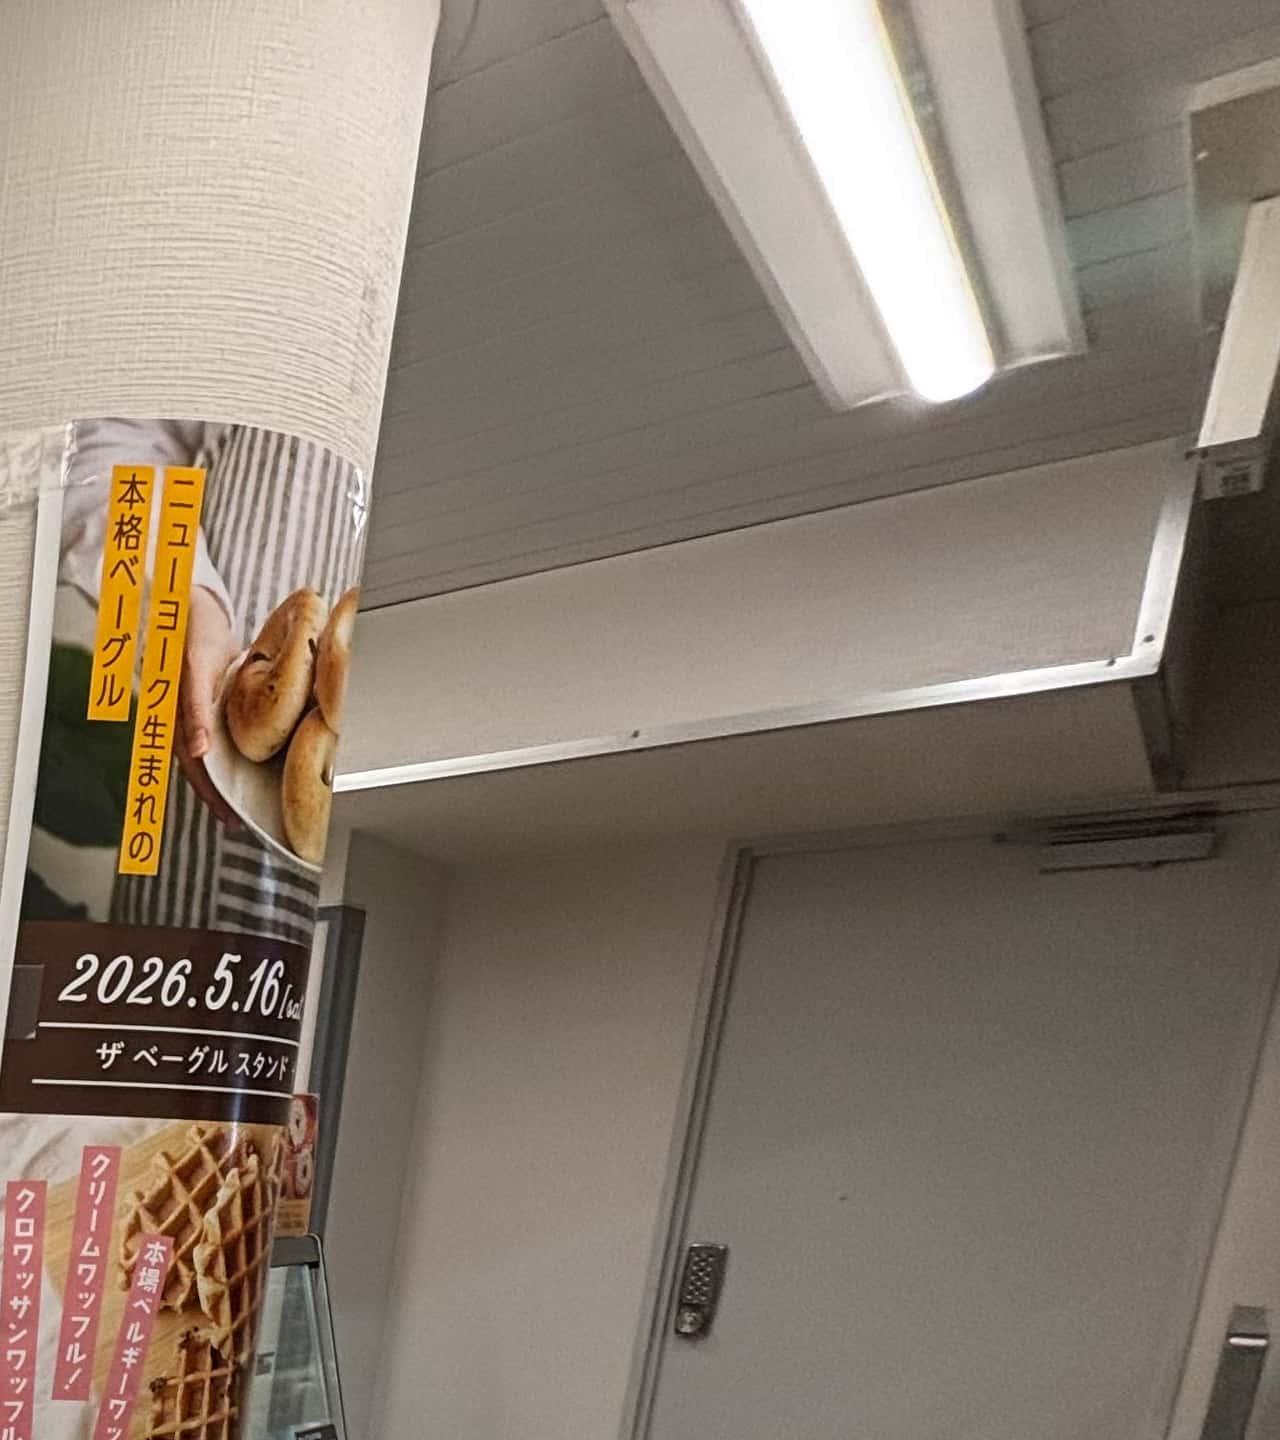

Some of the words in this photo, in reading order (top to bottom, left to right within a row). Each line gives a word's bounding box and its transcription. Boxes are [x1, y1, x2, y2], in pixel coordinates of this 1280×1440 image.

[95, 473, 147, 708] 本格ベーグル
[127, 478, 198, 863] ニューヨーク生まれの
[58, 953, 284, 1016] 2026.5.16
[96, 1041, 124, 1069] ザ
[133, 1045, 228, 1074] ベーグル
[235, 1052, 289, 1081] スタンド
[63, 1153, 111, 1392] クリームワッフル！
